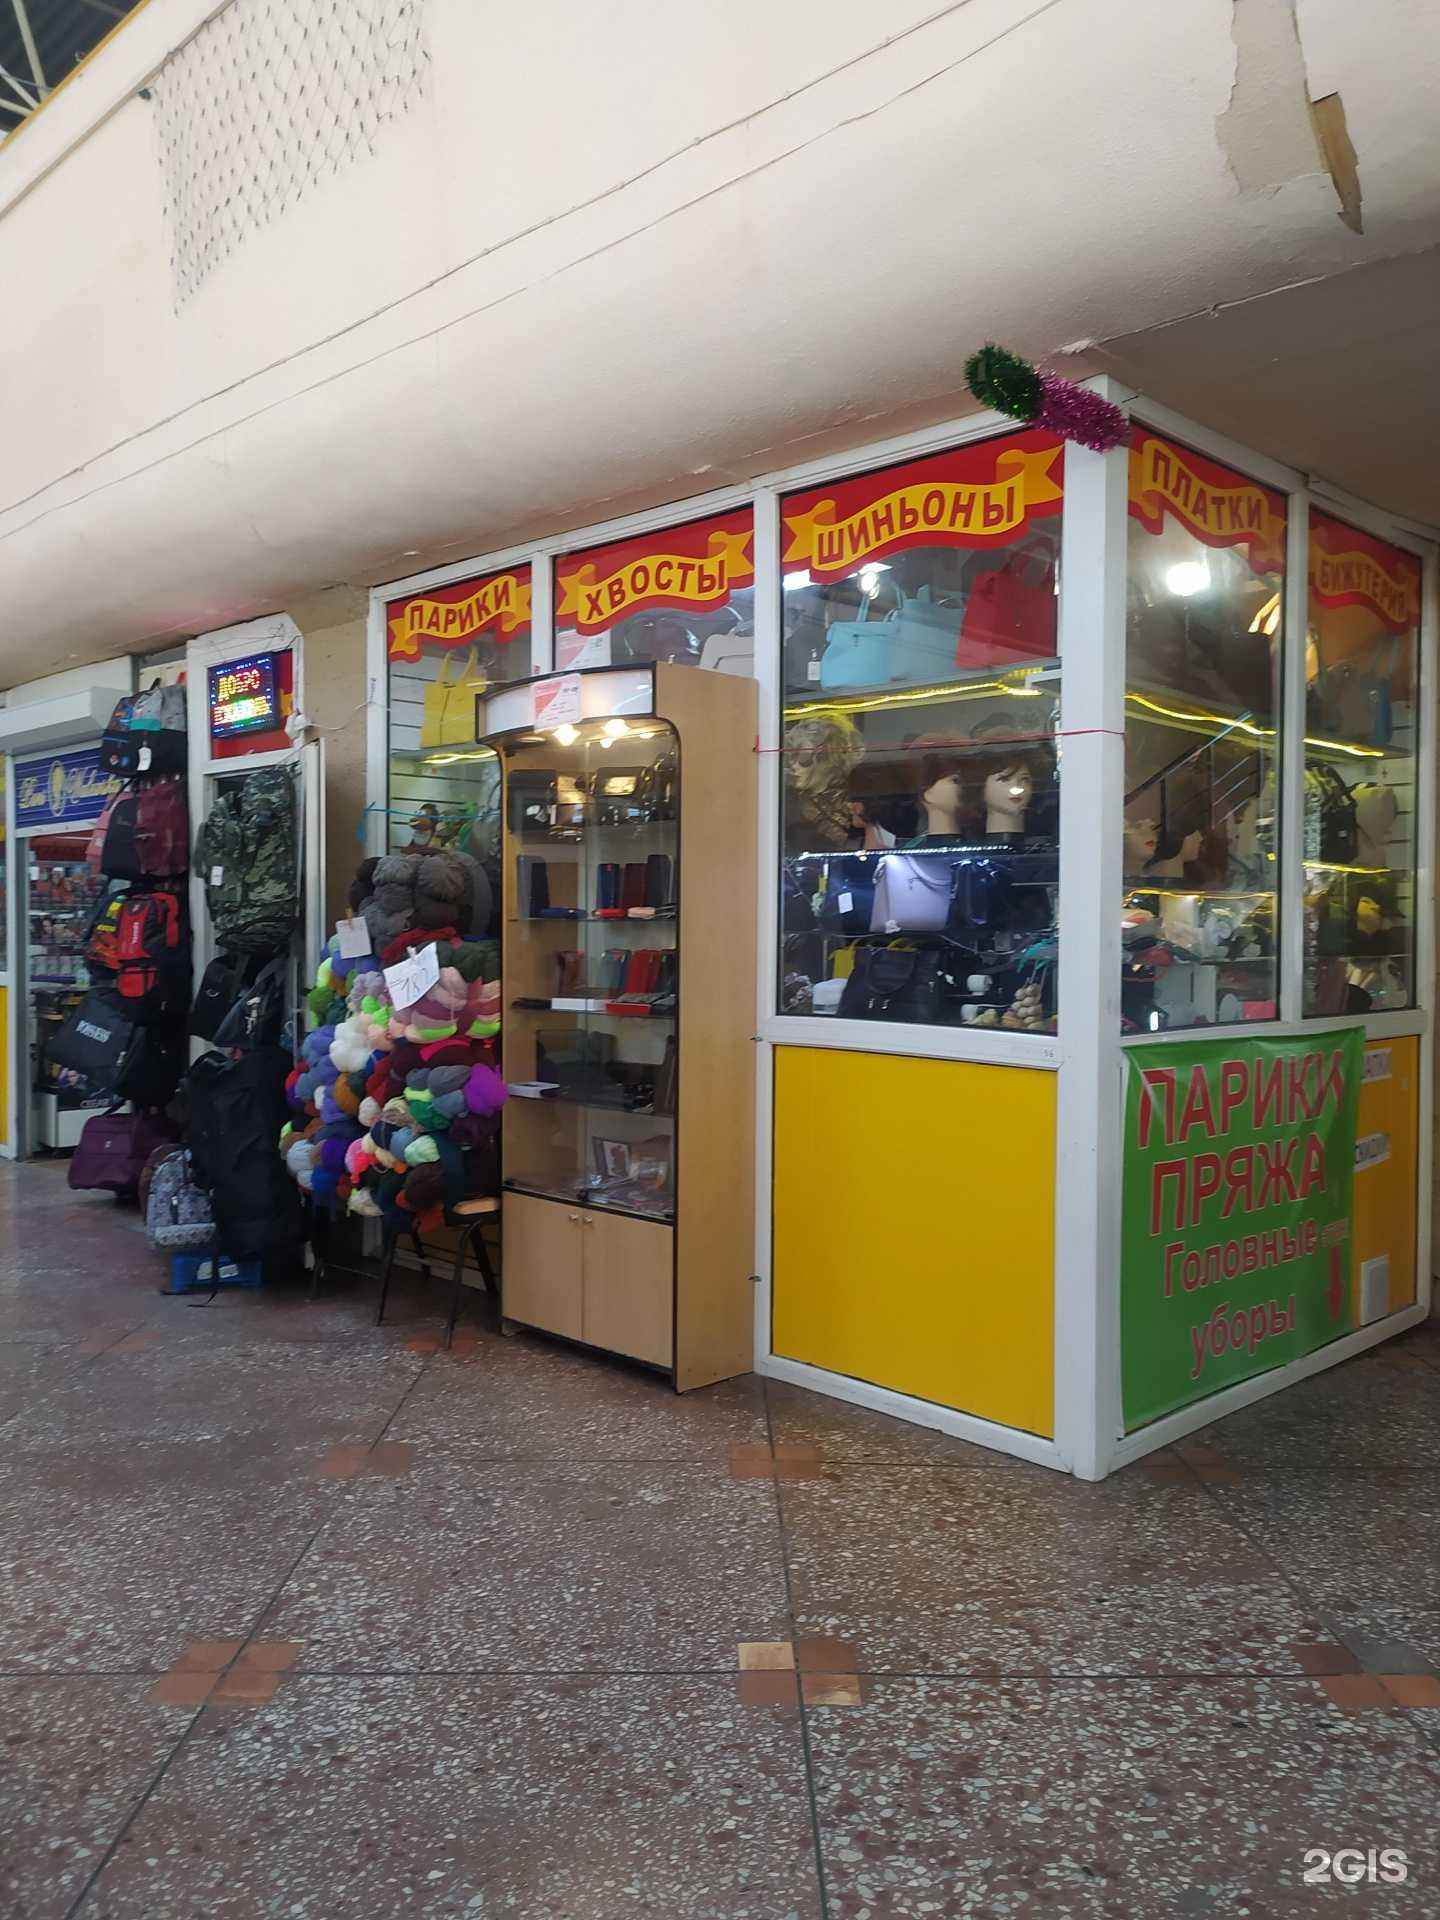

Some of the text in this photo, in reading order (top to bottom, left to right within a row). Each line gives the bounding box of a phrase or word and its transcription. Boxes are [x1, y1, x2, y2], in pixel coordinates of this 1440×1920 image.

[817, 486, 1016, 563] ШИНЬОНЫ
[1152, 447, 1263, 531] ПЛАТКИ
[409, 580, 511, 633] ПАРИКИ
[585, 559, 727, 621] ХВОСТЫ
[1138, 1049, 1345, 1150] ПАРИКИ
[1150, 1132, 1328, 1237] ПРЯЖА
[1163, 1218, 1318, 1298] Головные
[1189, 1294, 1297, 1380] уборы
